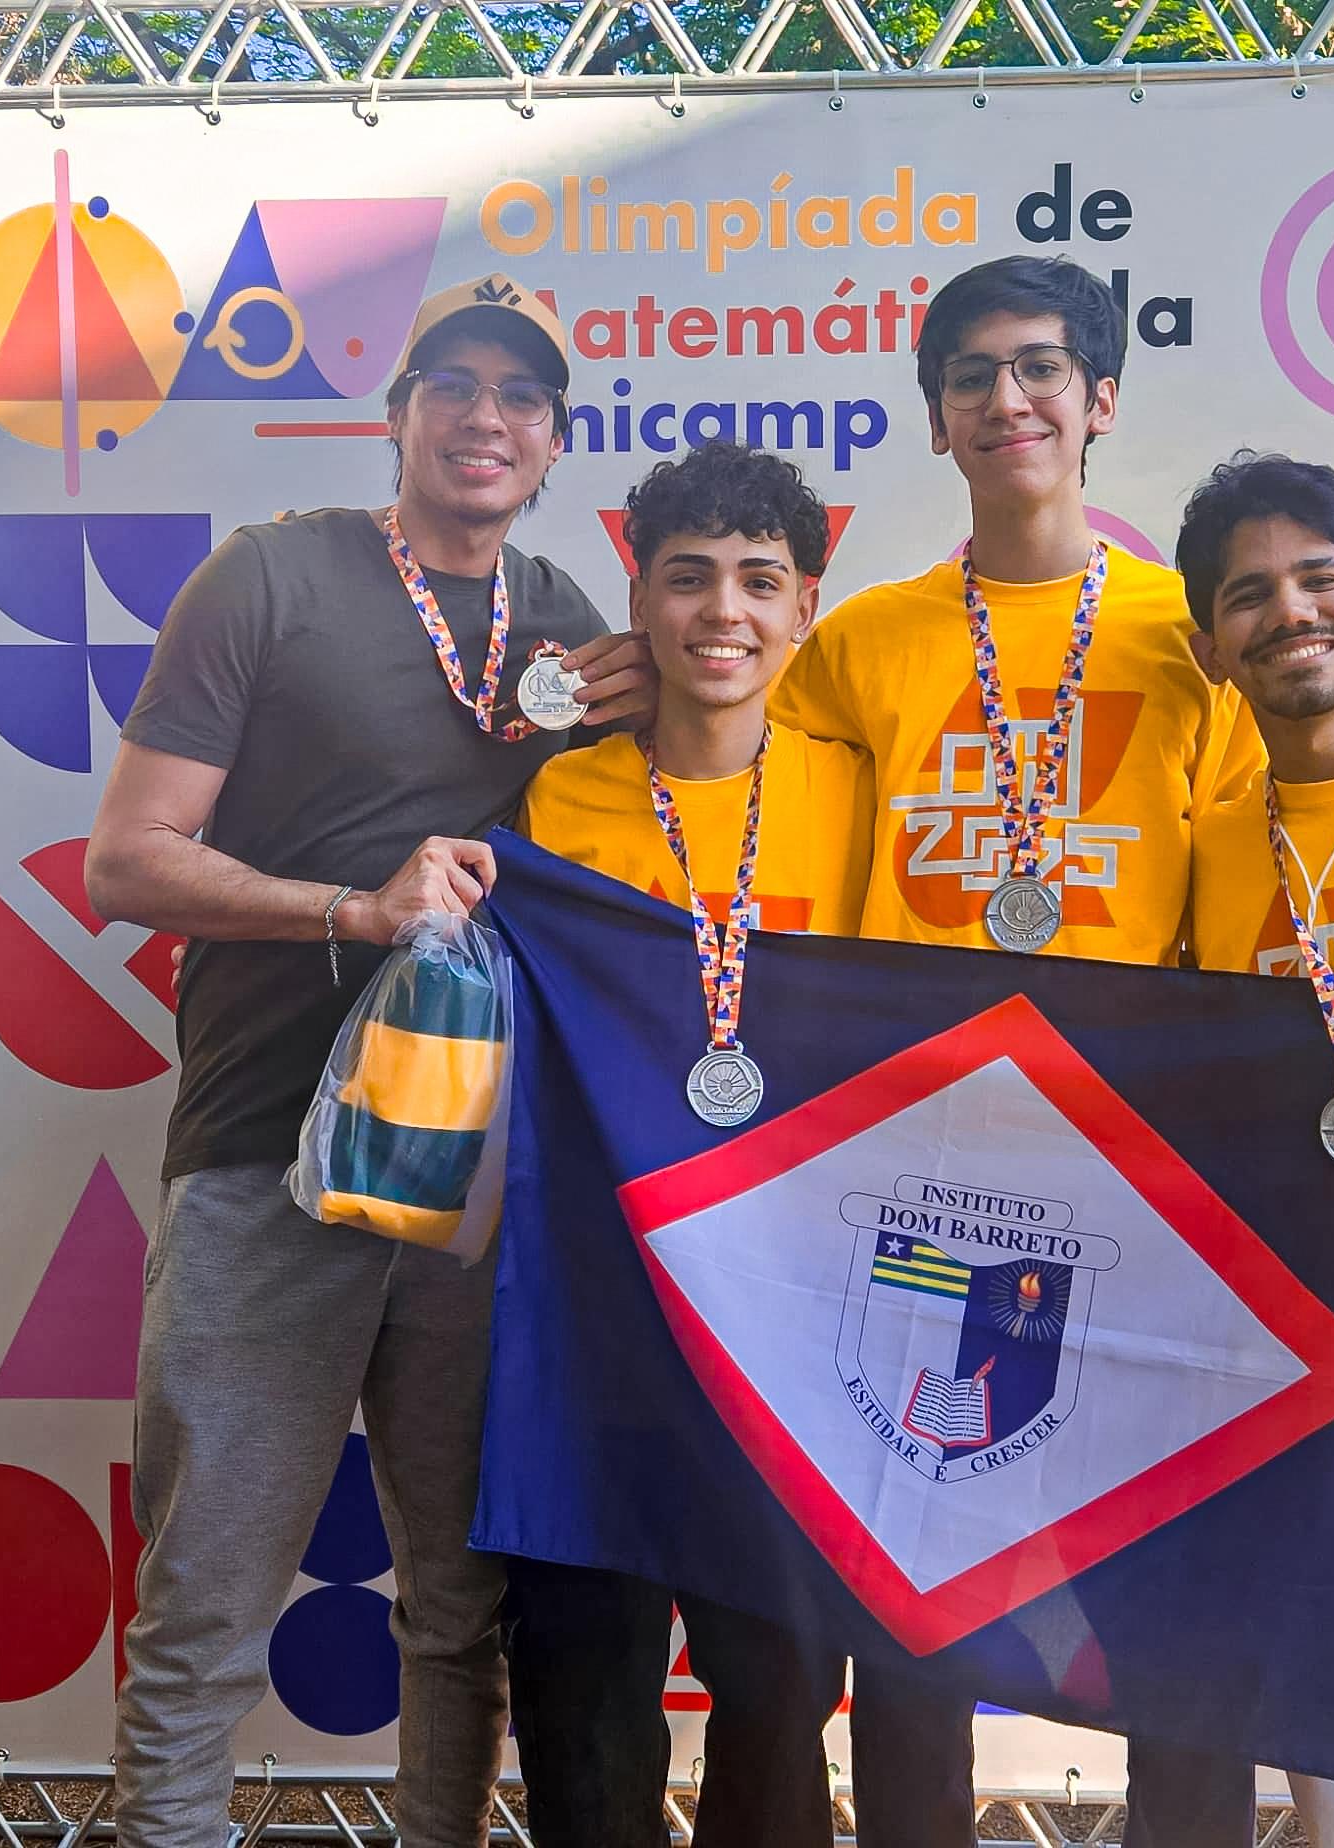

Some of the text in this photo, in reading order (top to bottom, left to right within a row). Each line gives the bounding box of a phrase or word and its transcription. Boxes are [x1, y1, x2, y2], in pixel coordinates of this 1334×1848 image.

[480, 162, 1133, 272] Olimpíada de
[534, 276, 929, 360] atemáti
[564, 378, 888, 471] nicamp
[877, 1204, 1082, 1260] DOM BARRETO
[921, 1184, 1046, 1222] INSTITUTO
[846, 1376, 1060, 1482] ESTUDAR E CRESCER
